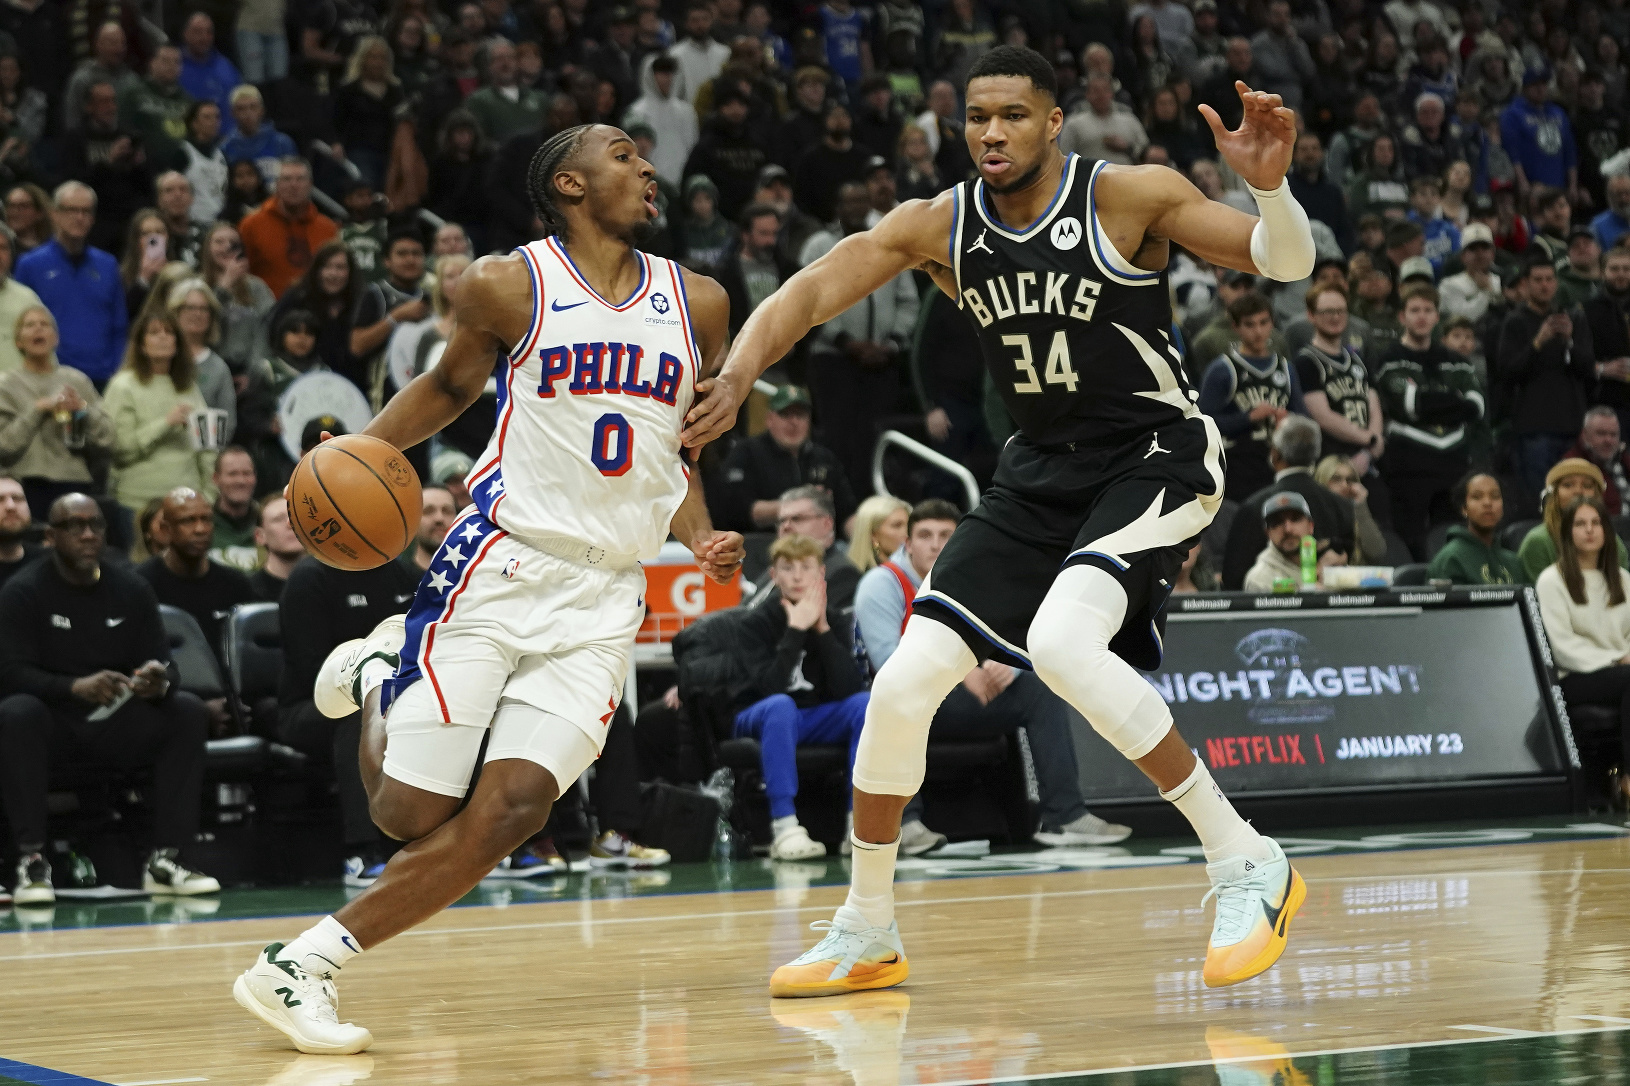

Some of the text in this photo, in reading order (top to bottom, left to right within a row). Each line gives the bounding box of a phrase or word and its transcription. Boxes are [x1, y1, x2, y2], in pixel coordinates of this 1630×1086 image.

[962, 271, 1104, 328] BUCKS
[645, 317, 681, 326] crypto.com
[537, 342, 684, 407] PHILA
[1000, 329, 1081, 394] 34
[591, 413, 634, 476] 0
[670, 571, 706, 616] G
[1182, 598, 1232, 610] ticketmaster
[1255, 597, 1303, 609] ticketmaster
[1329, 595, 1376, 606] ticketmaster
[1401, 592, 1447, 603] ticketmaster
[1469, 590, 1515, 601] ticketmaster
[1144, 664, 1423, 702] NIGHT AGENT
[1206, 734, 1307, 769] NETFLIX
[1336, 734, 1433, 760] JANUARY
[1436, 733, 1464, 755] 23
[274, 986, 303, 1009] N
